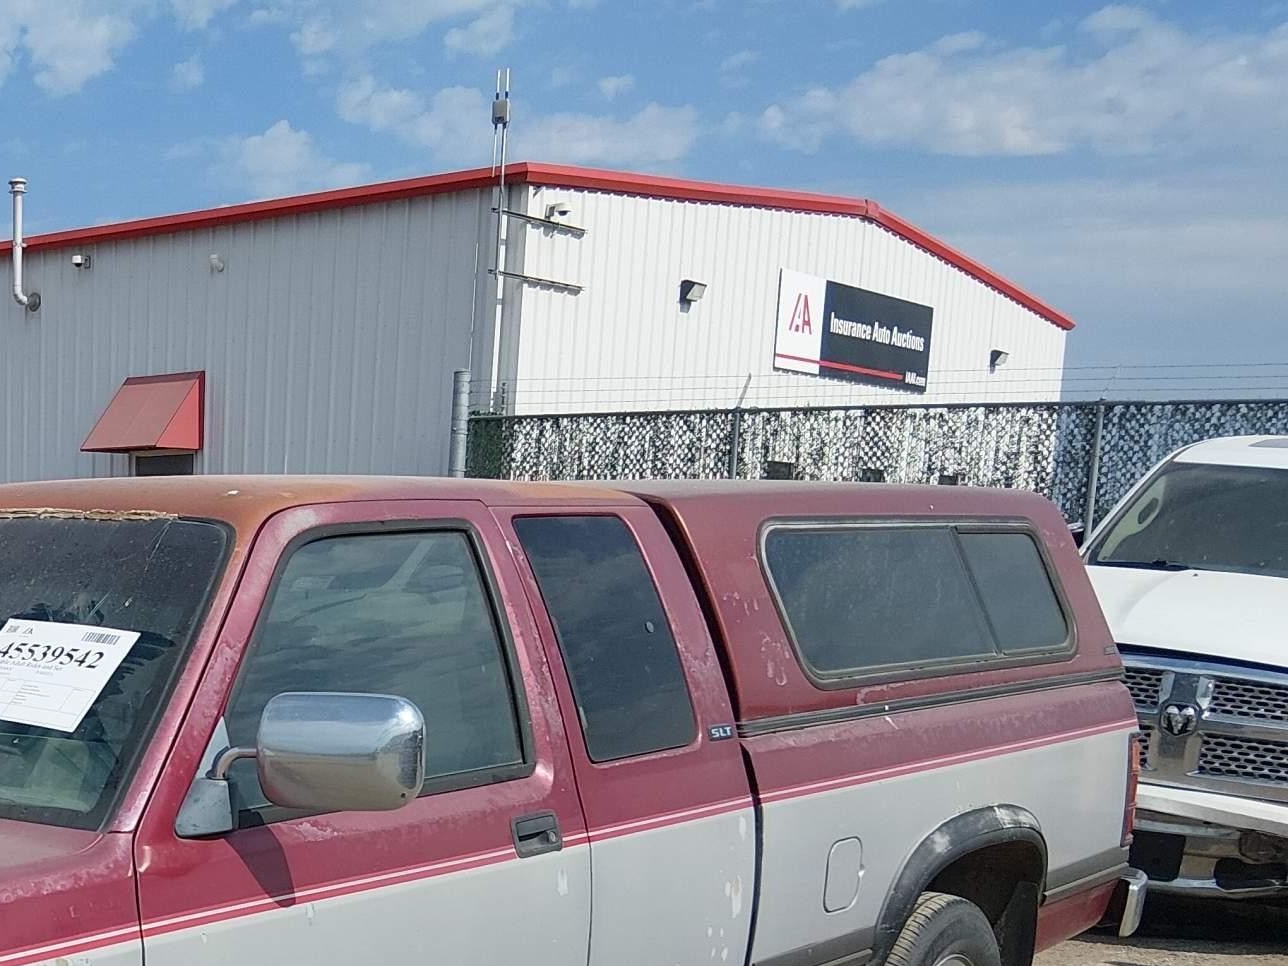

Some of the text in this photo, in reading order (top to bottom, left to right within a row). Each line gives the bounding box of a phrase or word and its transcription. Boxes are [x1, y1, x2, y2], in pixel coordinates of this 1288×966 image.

[830, 312, 925, 352] Insurance Auto Auctions
[712, 726, 731, 738] SLT
